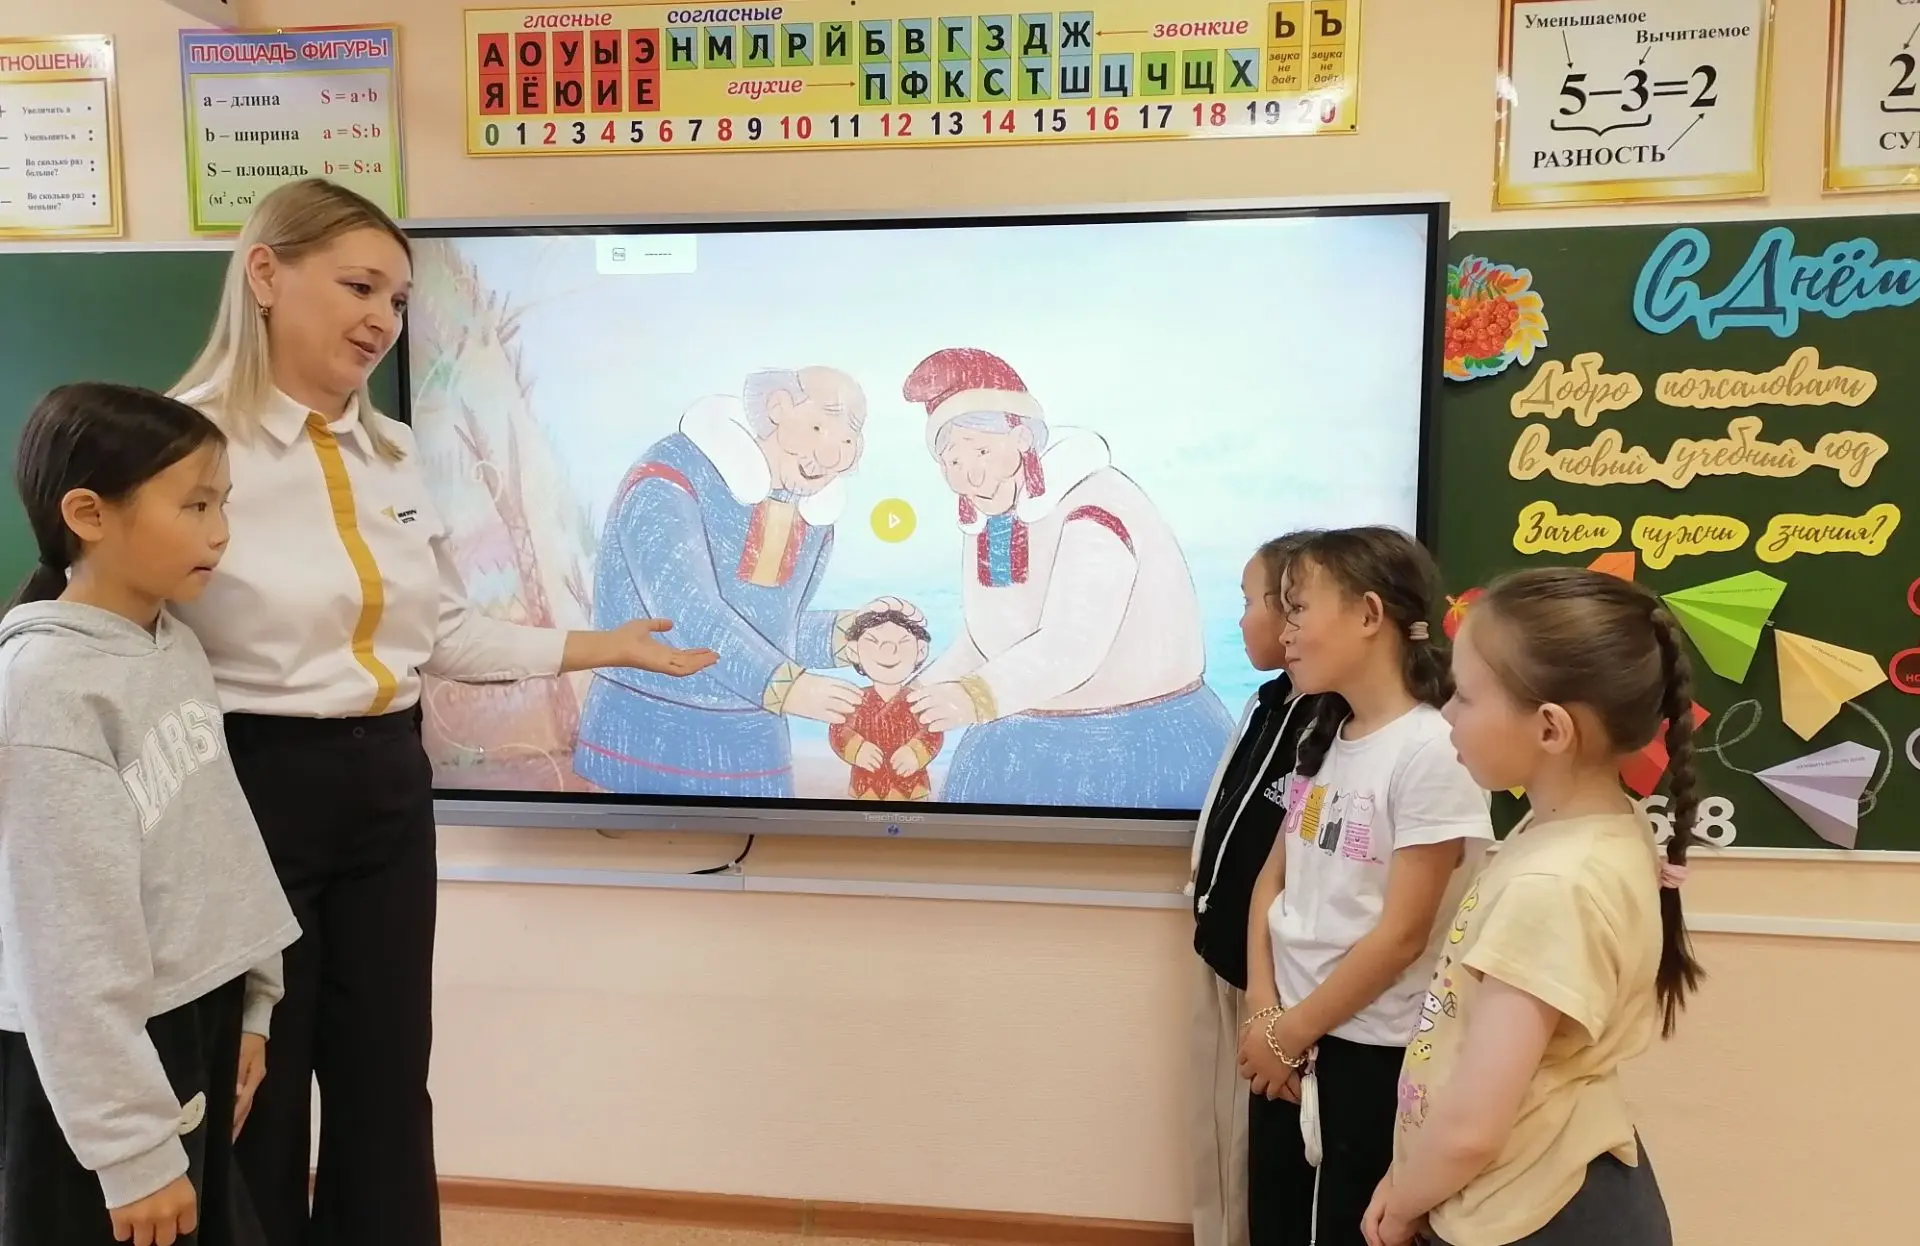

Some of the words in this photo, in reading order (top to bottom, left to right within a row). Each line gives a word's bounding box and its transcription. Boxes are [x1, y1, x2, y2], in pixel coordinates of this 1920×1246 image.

[523, 11, 612, 28] гласные
[667, 5, 783, 24] согласные
[1275, 11, 1295, 38] Ь
[1314, 9, 1342, 36] Ъ
[1525, 12, 1647, 29] Уменьшаемое
[1153, 19, 1248, 38] звонкие
[1636, 25, 1750, 44] Вычитаемое
[191, 44, 296, 63] ПЛОЩАДЬ
[302, 39, 388, 59] ФИГУРЫ
[672, 37, 691, 61] Н
[709, 36, 731, 60] М
[749, 35, 769, 60] Л
[789, 34, 806, 58] Р
[827, 25, 845, 56] Й
[866, 30, 885, 55] Б
[906, 29, 924, 54] В
[948, 27, 964, 52] Г
[986, 25, 1004, 51] З
[1024, 23, 1047, 55] Д
[1062, 21, 1090, 48] Ж
[484, 43, 504, 67] А
[520, 41, 541, 66] О
[560, 41, 578, 66] У
[595, 40, 618, 64] Ы
[635, 38, 656, 63] Э
[1269, 52, 1300, 63] звука
[1311, 51, 1343, 61] звука
[1320, 63, 1333, 71] не
[1888, 53, 1917, 97] 2
[727, 78, 803, 99] глухие
[866, 74, 885, 100] П
[901, 71, 927, 98] Ф
[946, 71, 964, 97] К
[984, 69, 1004, 95] С
[1026, 68, 1044, 94] Т
[1061, 66, 1089, 93] Ш
[1105, 65, 1127, 97] Ц
[1148, 63, 1166, 89] Ч
[1185, 62, 1213, 94] Щ
[1231, 60, 1252, 87] Х
[1271, 75, 1296, 85] даёт
[230, 95, 280, 108] длина
[321, 89, 330, 104] S
[486, 83, 503, 108] Я
[523, 77, 538, 108] Ё
[556, 81, 582, 106] Ю
[598, 80, 616, 105] И
[637, 79, 653, 104] Е
[486, 124, 499, 146] 0
[516, 123, 526, 145] 1
[543, 123, 556, 145] 2
[572, 122, 585, 144] 3
[600, 121, 615, 143] 4
[630, 121, 643, 143] 5
[659, 120, 673, 142] 6
[688, 119, 702, 141] 7
[718, 118, 732, 141] 8
[748, 118, 762, 140] 9
[780, 116, 811, 139] 10
[830, 115, 859, 137] 11
[881, 113, 911, 136] 12
[931, 112, 962, 135] 13
[982, 110, 1015, 133] 14
[1034, 109, 1066, 132] 15
[1087, 107, 1119, 130] 16
[1140, 105, 1172, 128] 17
[1193, 103, 1226, 126] 18
[1247, 101, 1280, 124] 19
[1299, 99, 1336, 123] 20
[205, 128, 215, 142] b
[234, 129, 299, 145] ширина
[1879, 131, 1920, 151] СУ
[1533, 144, 1666, 169] РАЗНОСТЬ
[207, 163, 217, 177] S
[236, 163, 308, 177] площадь
[324, 162, 333, 175] b
[1644, 238, 1697, 322] С
[1520, 361, 1633, 417] Добро
[1664, 356, 1865, 400] пожаловать
[1518, 432, 1541, 471] в
[1559, 438, 1648, 477] новый
[1672, 426, 1801, 480] учебный
[1825, 439, 1878, 478] год
[1525, 511, 1609, 543] Зачем
[1768, 515, 1888, 551] знания?
